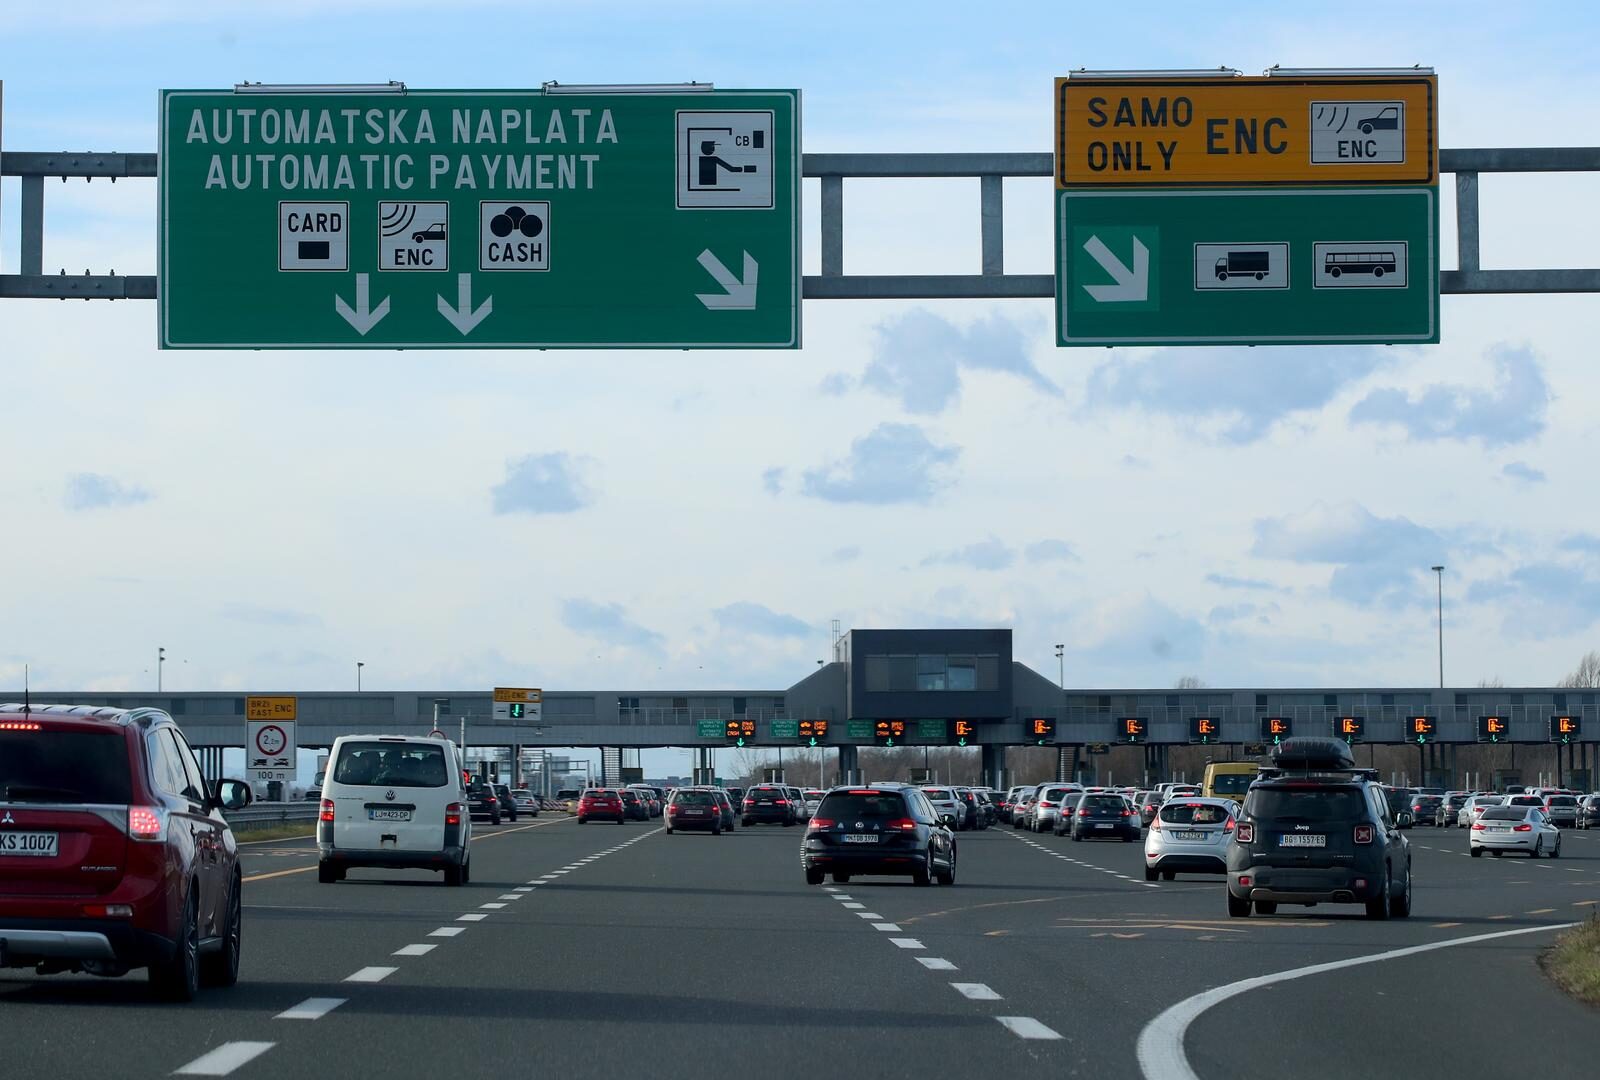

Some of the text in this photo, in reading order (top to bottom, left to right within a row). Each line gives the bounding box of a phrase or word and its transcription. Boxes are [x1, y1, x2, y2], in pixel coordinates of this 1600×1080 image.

[1088, 97, 1193, 128] SAMO
[186, 108, 619, 145] AUTOMATSKA NAPLATA
[1207, 117, 1288, 155] ENC
[735, 136, 750, 147] CB
[1338, 140, 1378, 158] ENC
[1087, 140, 1178, 172] ONLY
[205, 154, 600, 190] AUTOMATIC PAYMENT
[287, 213, 342, 233] CARD
[395, 249, 434, 266] ENC
[488, 243, 542, 263] CASH
[250, 709, 273, 717] FAST
[274, 705, 292, 713] ENC
[258, 771, 273, 780] 100
[20, 835, 56, 850] 1007
